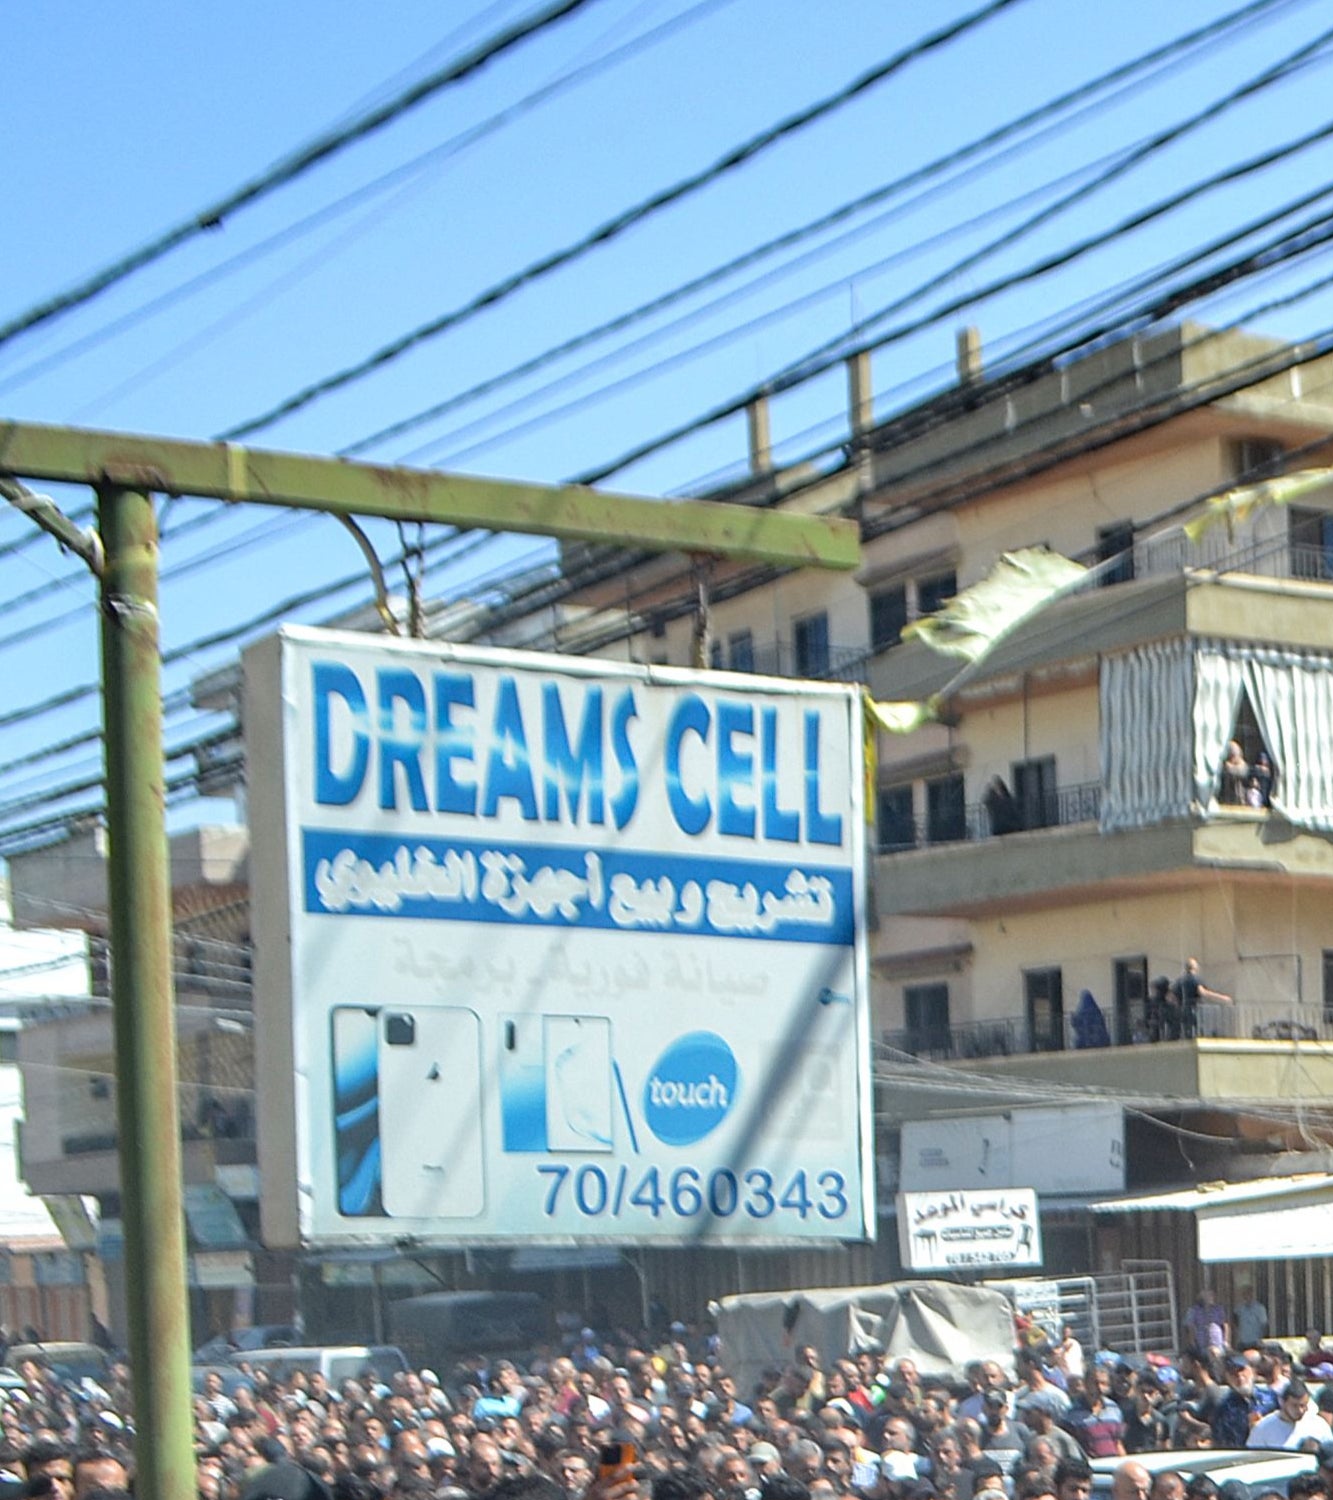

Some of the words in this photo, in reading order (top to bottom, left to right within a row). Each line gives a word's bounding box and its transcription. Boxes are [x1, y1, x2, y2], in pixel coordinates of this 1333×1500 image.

[311, 660, 641, 832] DREAMS
[665, 690, 844, 847] CELL
[609, 872, 676, 929] بيع
[649, 1074, 728, 1108] touch
[536, 1163, 849, 1221] 70/460343
